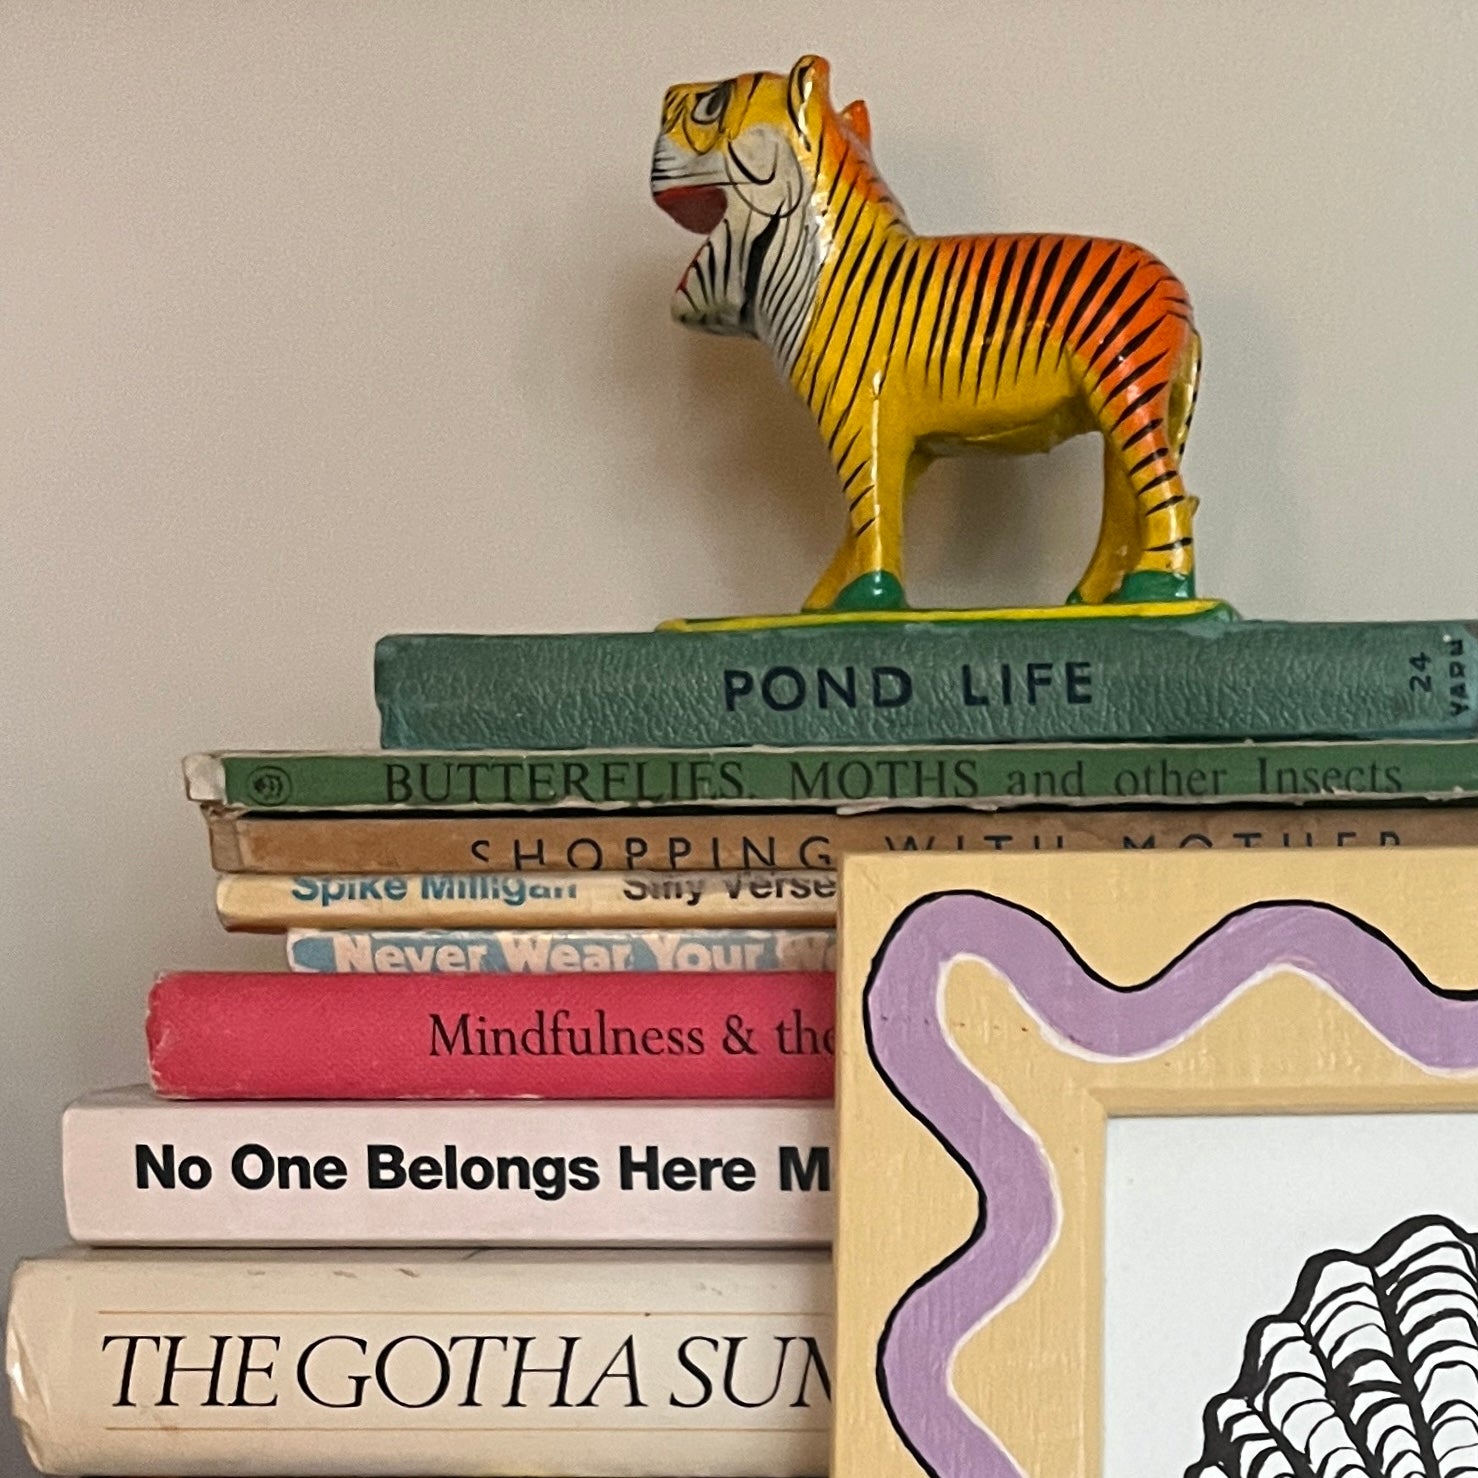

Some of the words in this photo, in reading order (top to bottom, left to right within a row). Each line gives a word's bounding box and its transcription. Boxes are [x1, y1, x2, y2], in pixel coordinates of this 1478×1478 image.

[724, 666, 912, 712] POND
[961, 661, 1093, 706] LIFE
[1408, 651, 1431, 692] 24
[789, 758, 978, 800] MOTHS
[1005, 759, 1085, 797] and
[1115, 757, 1228, 797] other
[1257, 755, 1402, 795] Insects
[471, 835, 833, 870] SHOPPING
[291, 875, 407, 907] Spike
[333, 933, 489, 972] Never
[497, 933, 632, 972] Wear
[641, 933, 765, 972] Your
[429, 1009, 706, 1058] Mindfulness
[722, 1014, 758, 1055] &
[135, 1143, 212, 1191] No
[231, 1142, 348, 1191] One
[367, 1144, 600, 1201] Belongs
[620, 1146, 756, 1192] Here
[102, 1334, 282, 1409] THE
[296, 1334, 648, 1409] GOTHA
